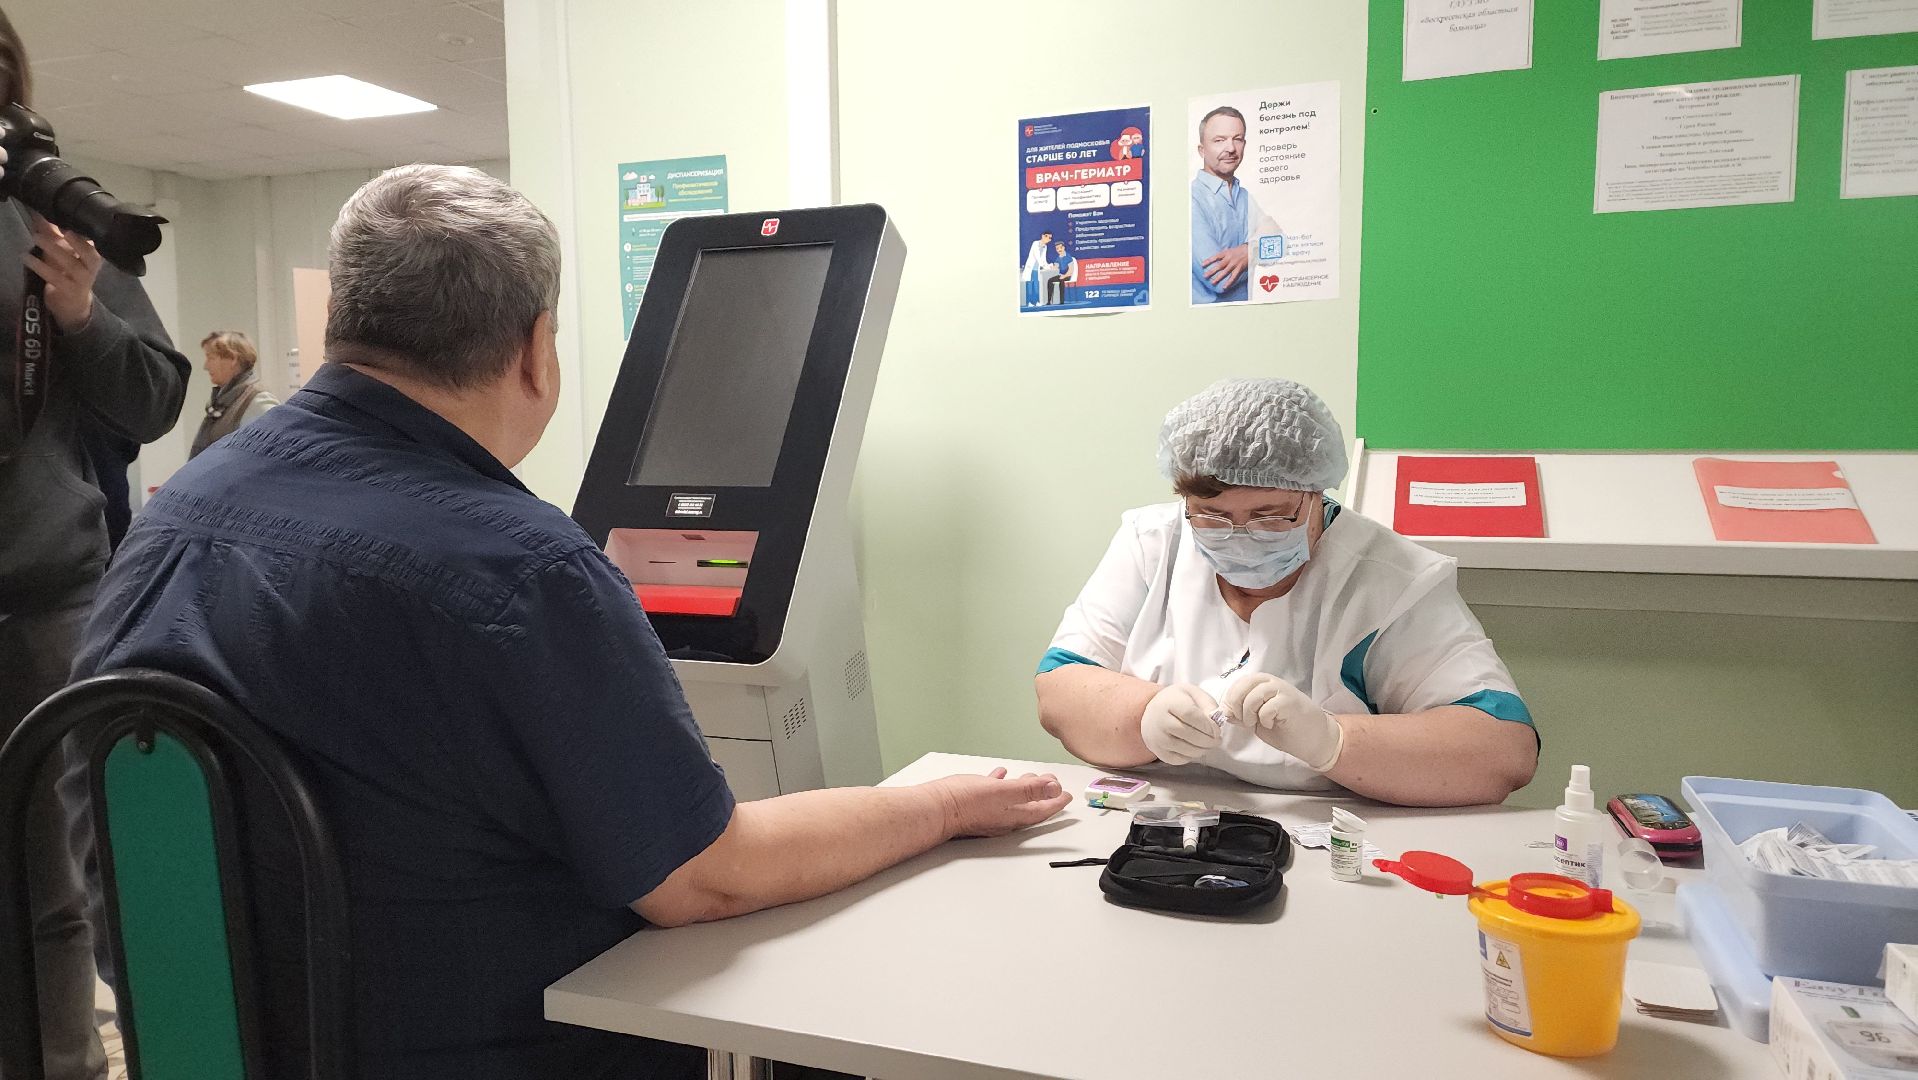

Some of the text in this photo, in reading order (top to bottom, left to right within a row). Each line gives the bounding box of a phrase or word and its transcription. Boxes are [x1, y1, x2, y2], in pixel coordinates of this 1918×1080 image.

[1259, 100, 1290, 110] Держи
[1259, 110, 1316, 122] болезнь под
[1259, 122, 1310, 135] контролем!
[1039, 142, 1065, 152] ЖИТЕЛЕЙ
[1066, 140, 1110, 149] ПОДМОСКОВЬЯ
[1258, 142, 1298, 154] Проверь
[1026, 150, 1098, 164] СТАРШЕ 60 ЛЕТ
[1259, 152, 1306, 163] состояние
[667, 168, 724, 180] ДИСПАНСЕРИЗАЦИЯ
[1036, 165, 1132, 184] ВРАЧ-ГЕРИАТР
[1259, 164, 1288, 174] своего
[1259, 174, 1300, 184] здоровья
[1085, 260, 1130, 270] НАПРАВЛЕНИЕ
[1084, 290, 1100, 298] 122
[24, 294, 40, 334] EOS
[24, 338, 40, 360] 6D
[24, 362, 36, 387] Mark
[1860, 1030, 1892, 1044] 96
